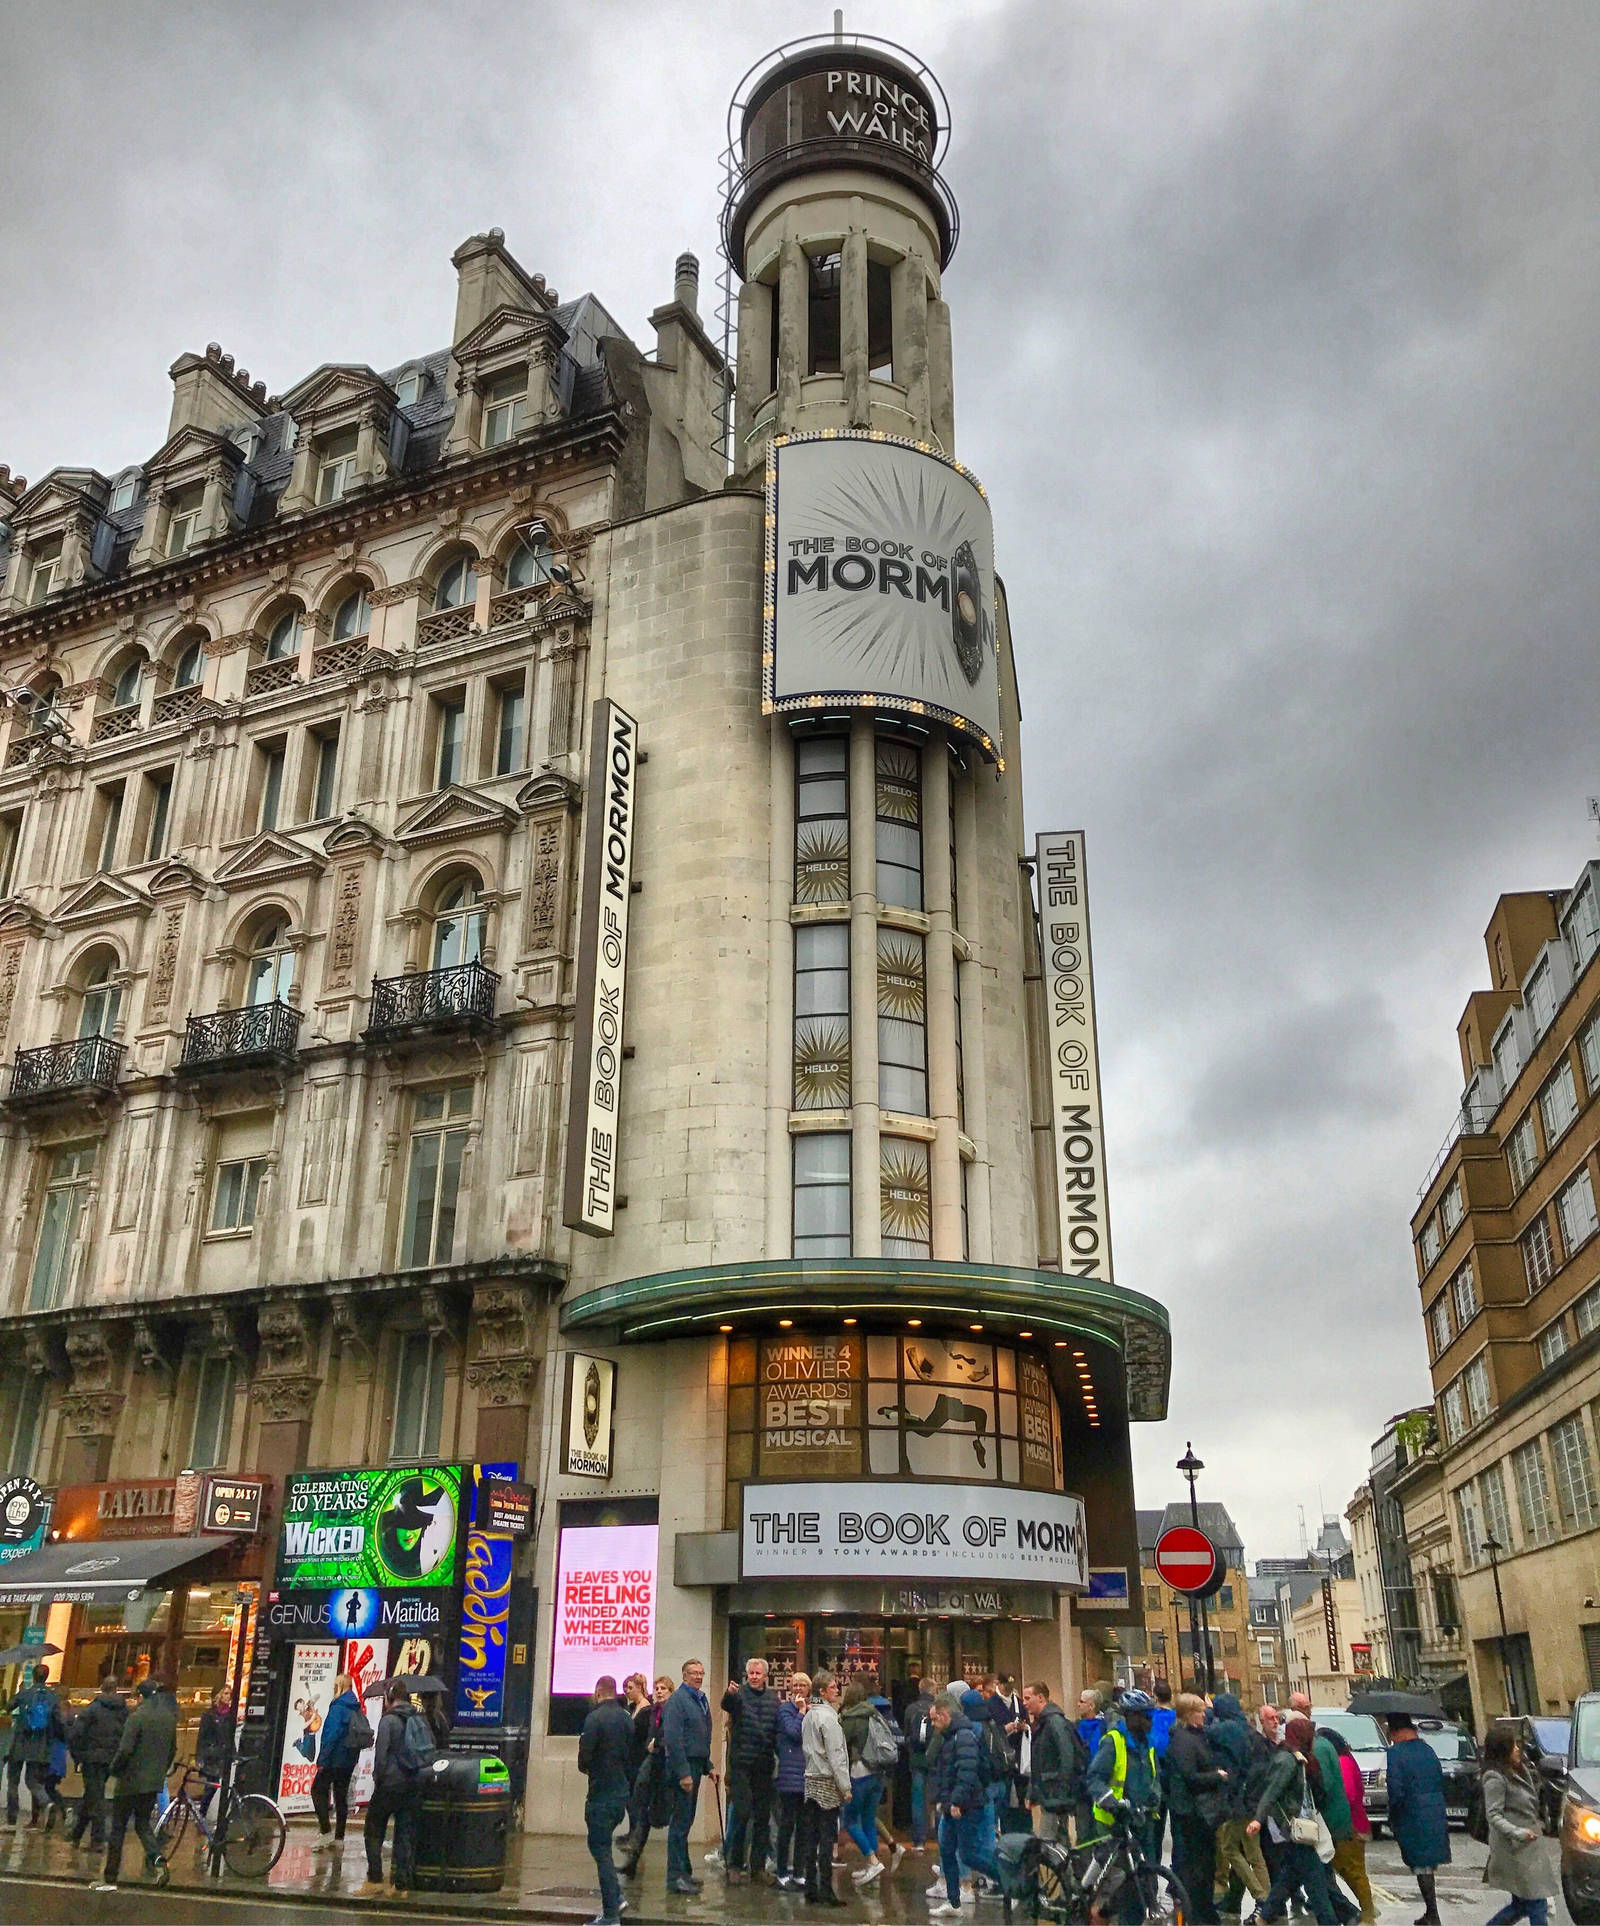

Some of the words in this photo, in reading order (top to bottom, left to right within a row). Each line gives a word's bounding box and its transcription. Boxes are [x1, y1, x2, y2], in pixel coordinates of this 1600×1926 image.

[827, 71, 929, 133] PRINCE
[874, 102, 898, 119] OF
[827, 110, 927, 165] WALES
[788, 536, 835, 556] THE
[845, 536, 914, 562] BOOK
[921, 550, 948, 572] OF
[883, 785, 912, 798] HELLO
[606, 714, 632, 902] MORMON
[805, 862, 839, 873] HELLO
[1046, 840, 1078, 907] THE
[602, 906, 622, 969] OF
[886, 975, 917, 989] HELLO
[1050, 922, 1086, 1027] BOOK
[594, 978, 620, 1112] BOOK
[804, 1063, 839, 1074] HELLO
[1057, 1039, 1090, 1091] OF
[588, 1127, 613, 1217] THE
[889, 1189, 921, 1203] HELLO
[1061, 1104, 1101, 1280] MORMON
[766, 1346, 836, 1361] WINNER
[839, 1345, 851, 1359] 4
[766, 1360, 851, 1381] OLIVIER
[767, 1382, 848, 1401] AWARDS
[766, 1399, 852, 1428] BEST
[765, 1429, 852, 1447] MUSICAL
[571, 1449, 582, 1458] THE
[583, 1450, 599, 1461] BOOK
[600, 1454, 608, 1462] OF
[570, 1457, 607, 1474] MORMON
[22, 1479, 36, 1493] 24
[32, 1488, 42, 1500] X
[215, 1486, 235, 1499] OPEN
[235, 1488, 245, 1500] 24
[245, 1490, 252, 1501] X
[251, 1490, 257, 1501] 7
[292, 1480, 369, 1495] CELEBRATING
[97, 1488, 175, 1519] LAYALI
[290, 1494, 309, 1513] 10
[312, 1491, 368, 1512] YEARS
[749, 1512, 820, 1544] THE
[838, 1512, 951, 1546] BOOK
[962, 1515, 1007, 1547] OF
[1, 1545, 32, 1561] expert
[756, 1548, 808, 1556] WINNER
[834, 1548, 871, 1556] TONY
[945, 1550, 1015, 1560] INCLUDING
[1021, 1554, 1045, 1563] BEST
[1049, 1557, 1079, 1566] MUSICAL
[622, 1570, 652, 1583] YOU
[564, 1585, 651, 1604] REELING
[270, 1604, 332, 1625] GENIUS
[381, 1601, 440, 1624] Matilda
[564, 1606, 618, 1618] WINDED
[621, 1605, 651, 1618] AND
[563, 1619, 650, 1635] WHEEZING
[563, 1636, 591, 1646] WITH
[280, 1779, 312, 1797] ROC
